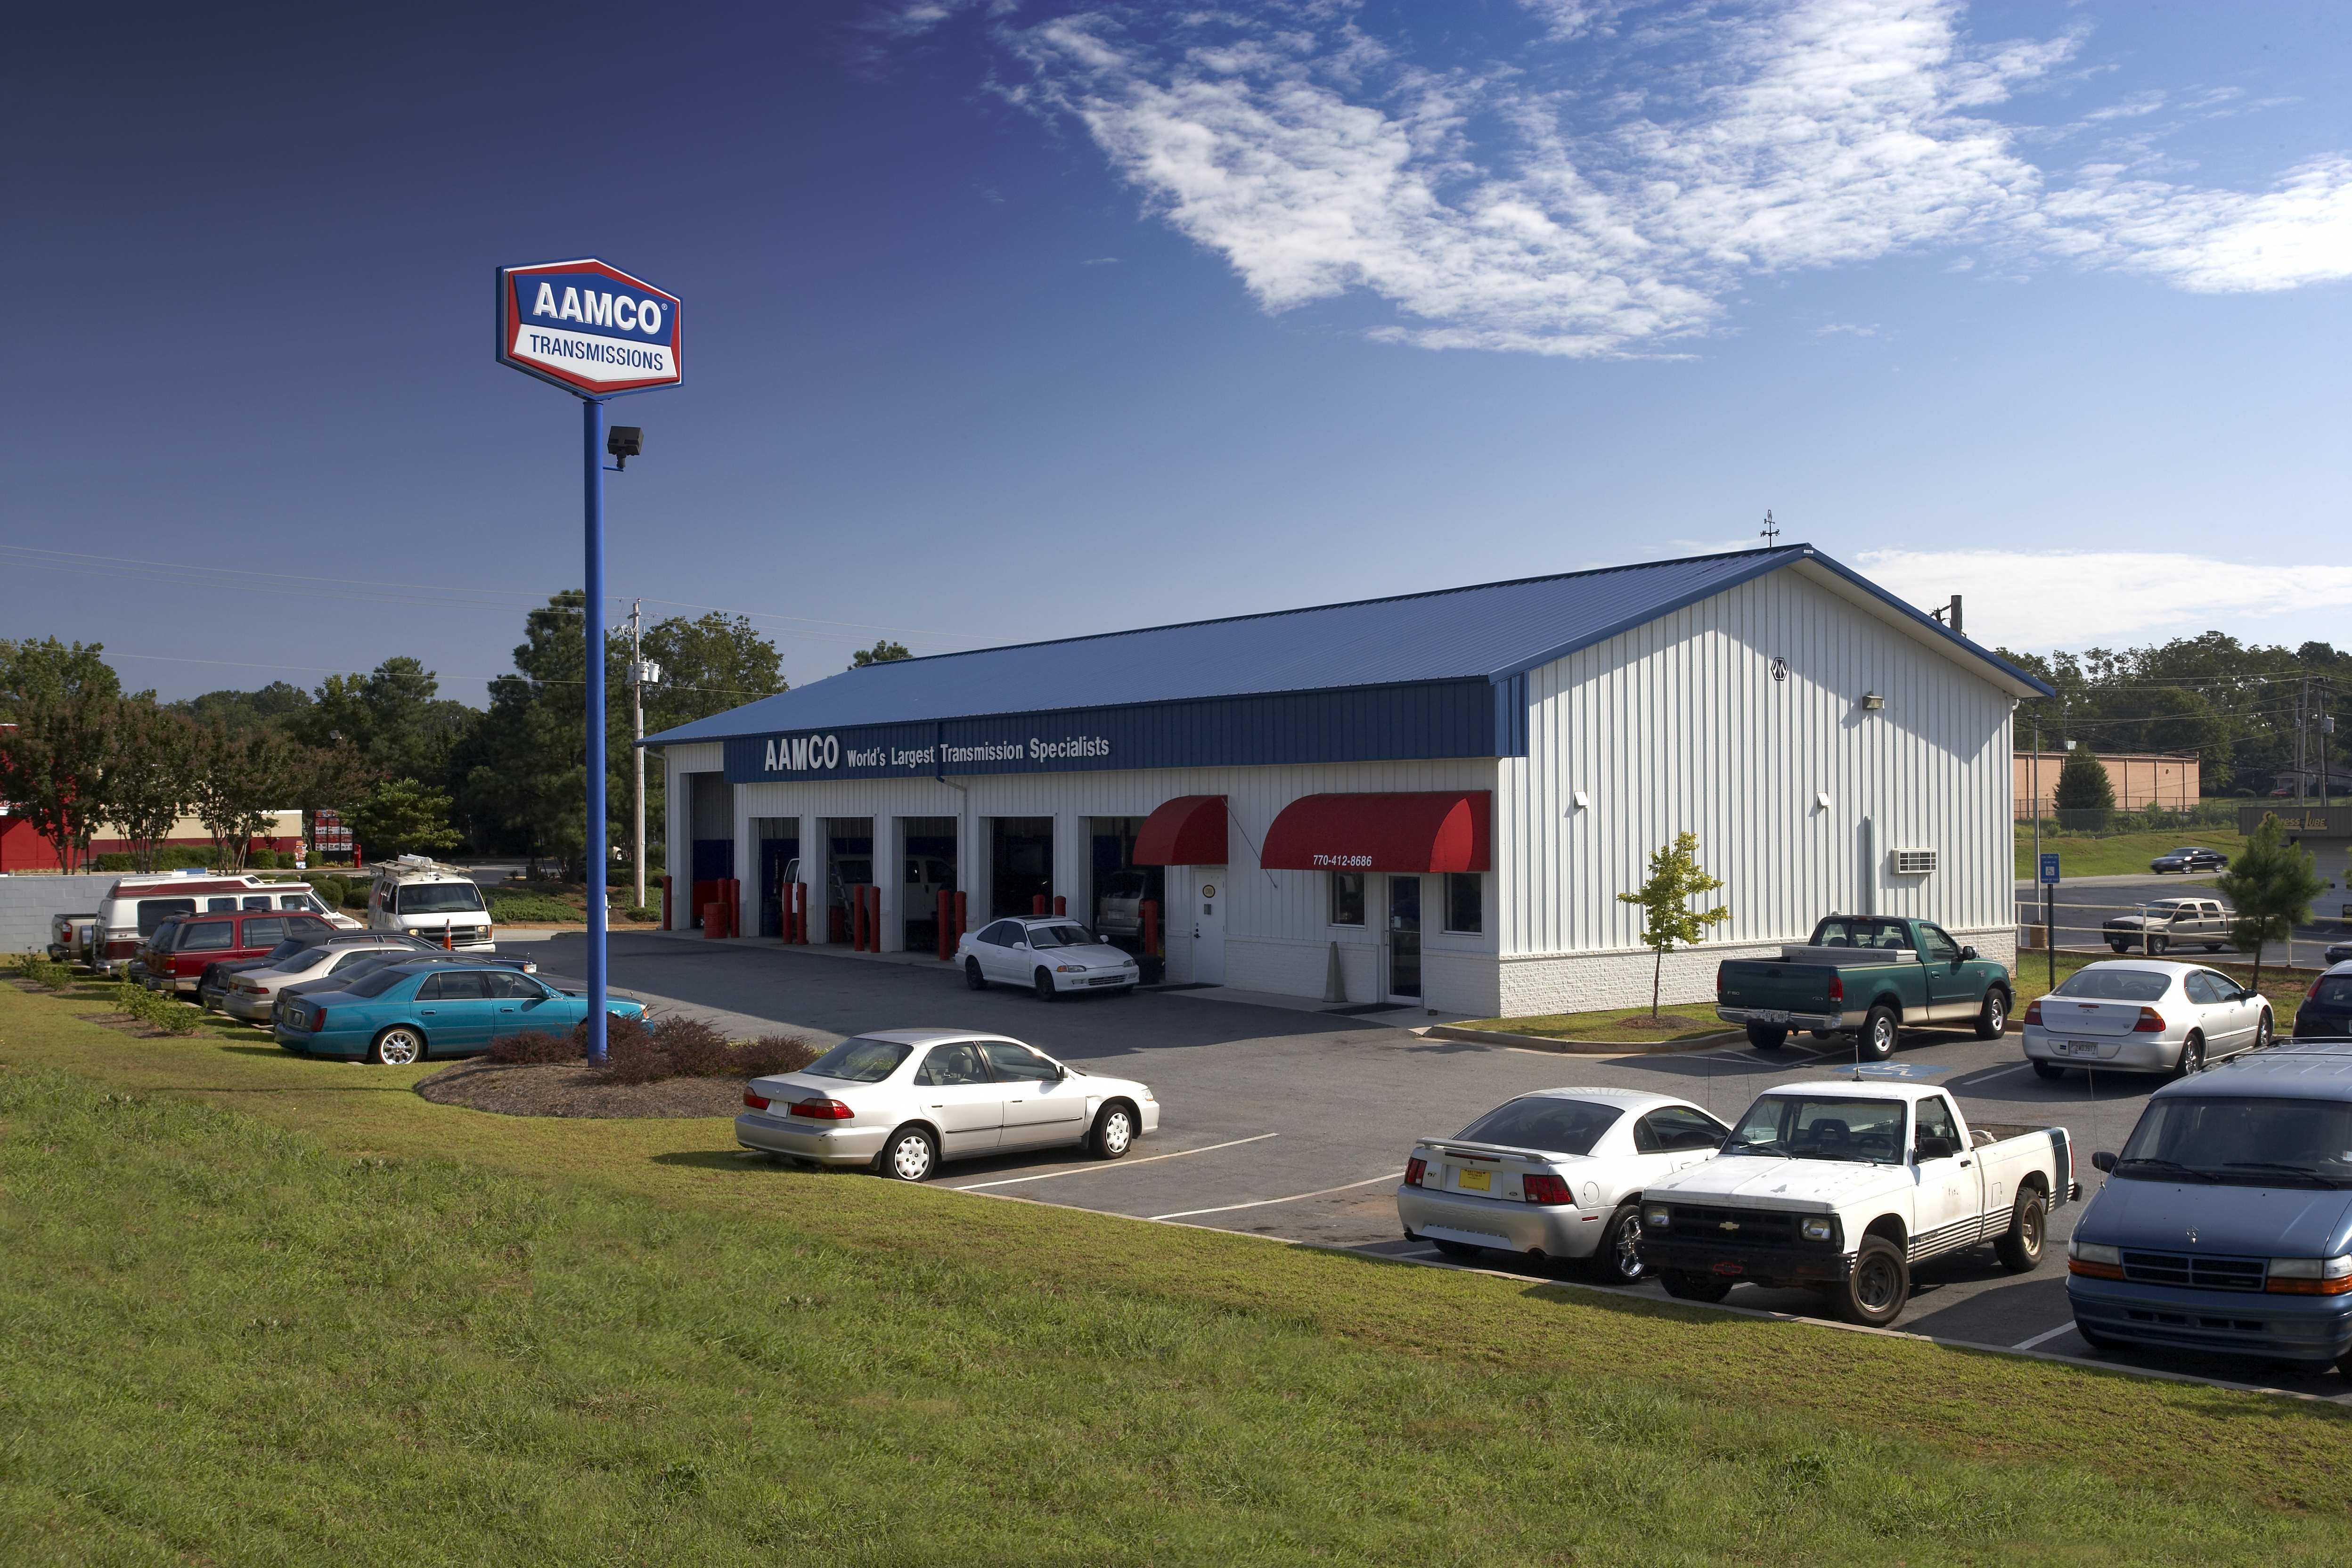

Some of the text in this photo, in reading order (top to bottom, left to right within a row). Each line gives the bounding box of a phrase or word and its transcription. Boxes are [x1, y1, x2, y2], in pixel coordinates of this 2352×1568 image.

[533, 282, 662, 335] AAMCO
[530, 334, 663, 371] TRANSMISSIONS
[765, 735, 1110, 771] AAMCO World's Largest Transmission Specialists
[1313, 855, 1372, 866] 770-412-8686
